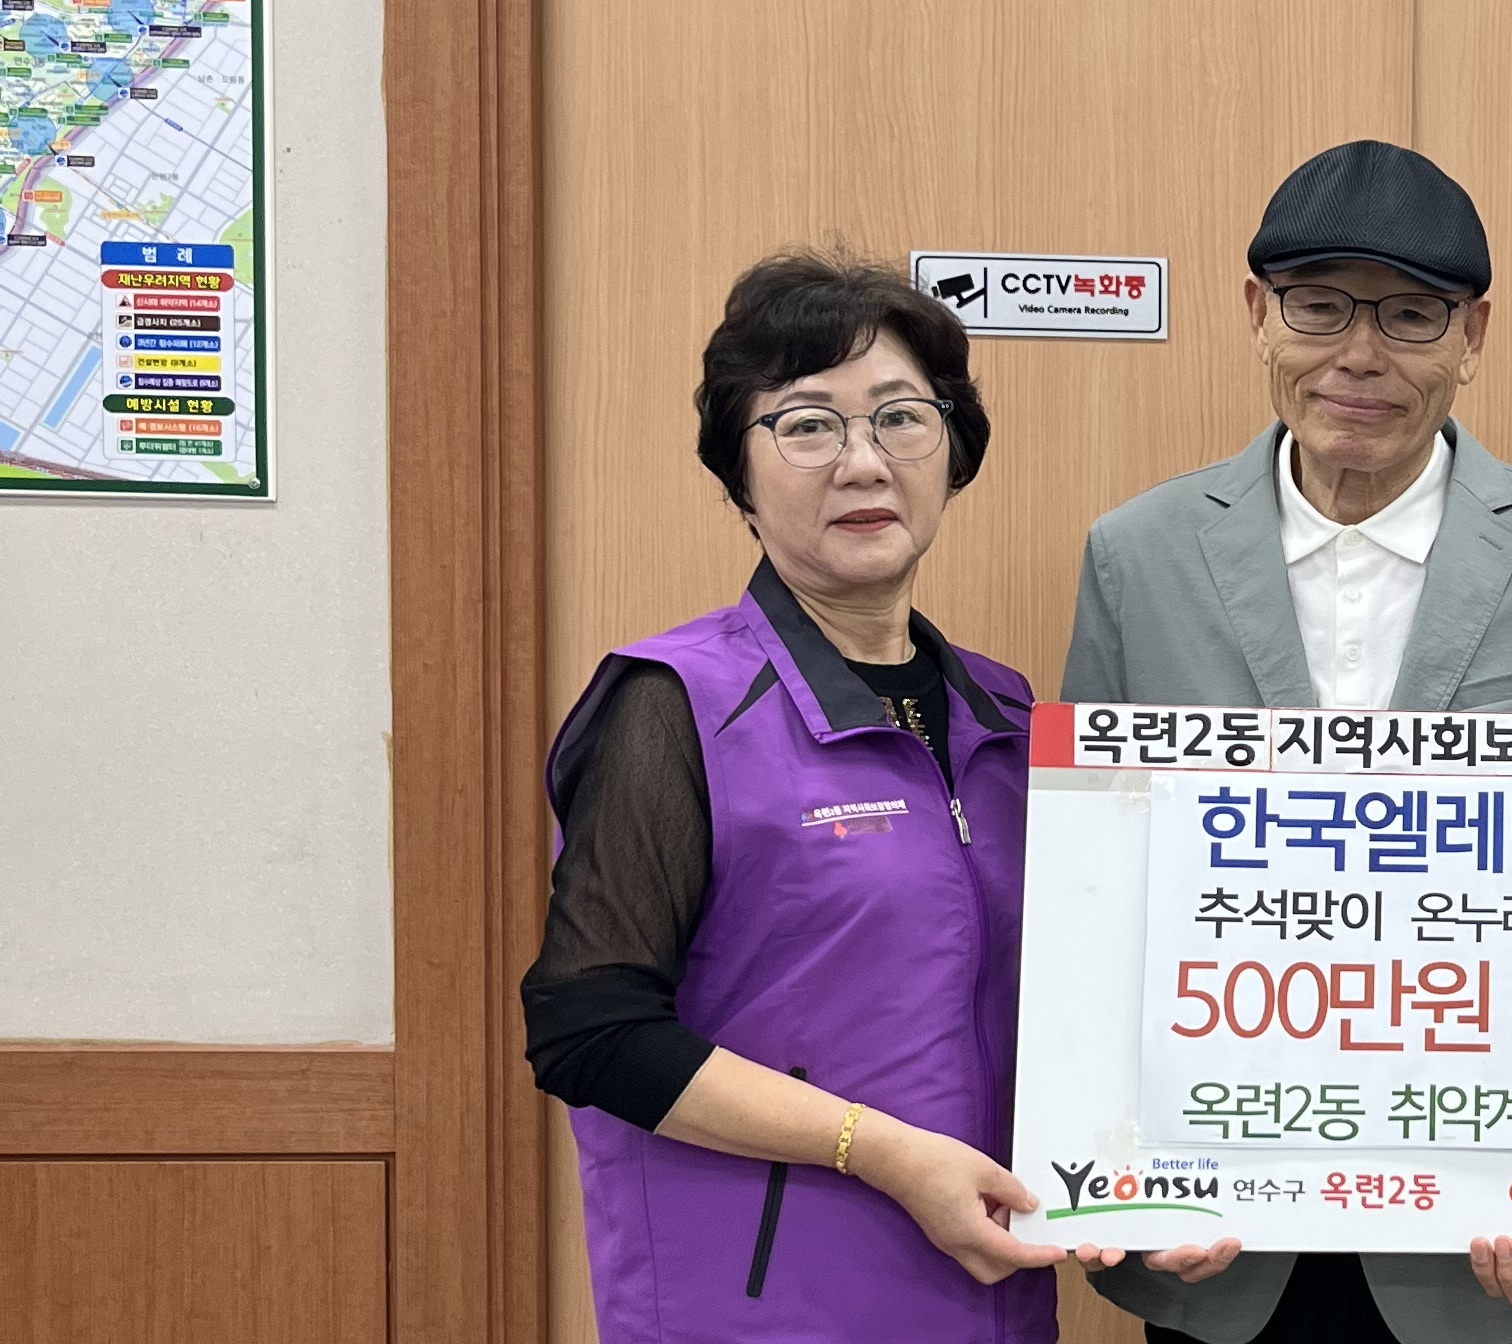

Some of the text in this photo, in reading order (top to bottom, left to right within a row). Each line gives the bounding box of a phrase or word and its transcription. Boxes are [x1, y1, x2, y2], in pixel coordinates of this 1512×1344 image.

[118, 273, 221, 289] 재난우려지역 현황
[1018, 303, 1130, 317] Video Camera Recording
[126, 398, 214, 413] 예방시설 현황
[1079, 709, 1266, 766] 옥련2동
[1194, 886, 1383, 942] 추석맞이
[1170, 959, 1491, 1053] 500만원
[1182, 1082, 1366, 1142] 옥련2동
[1051, 1159, 1441, 1212] Yeonsu 연수구 옥련2동
[1152, 1157, 1219, 1170] Better life
